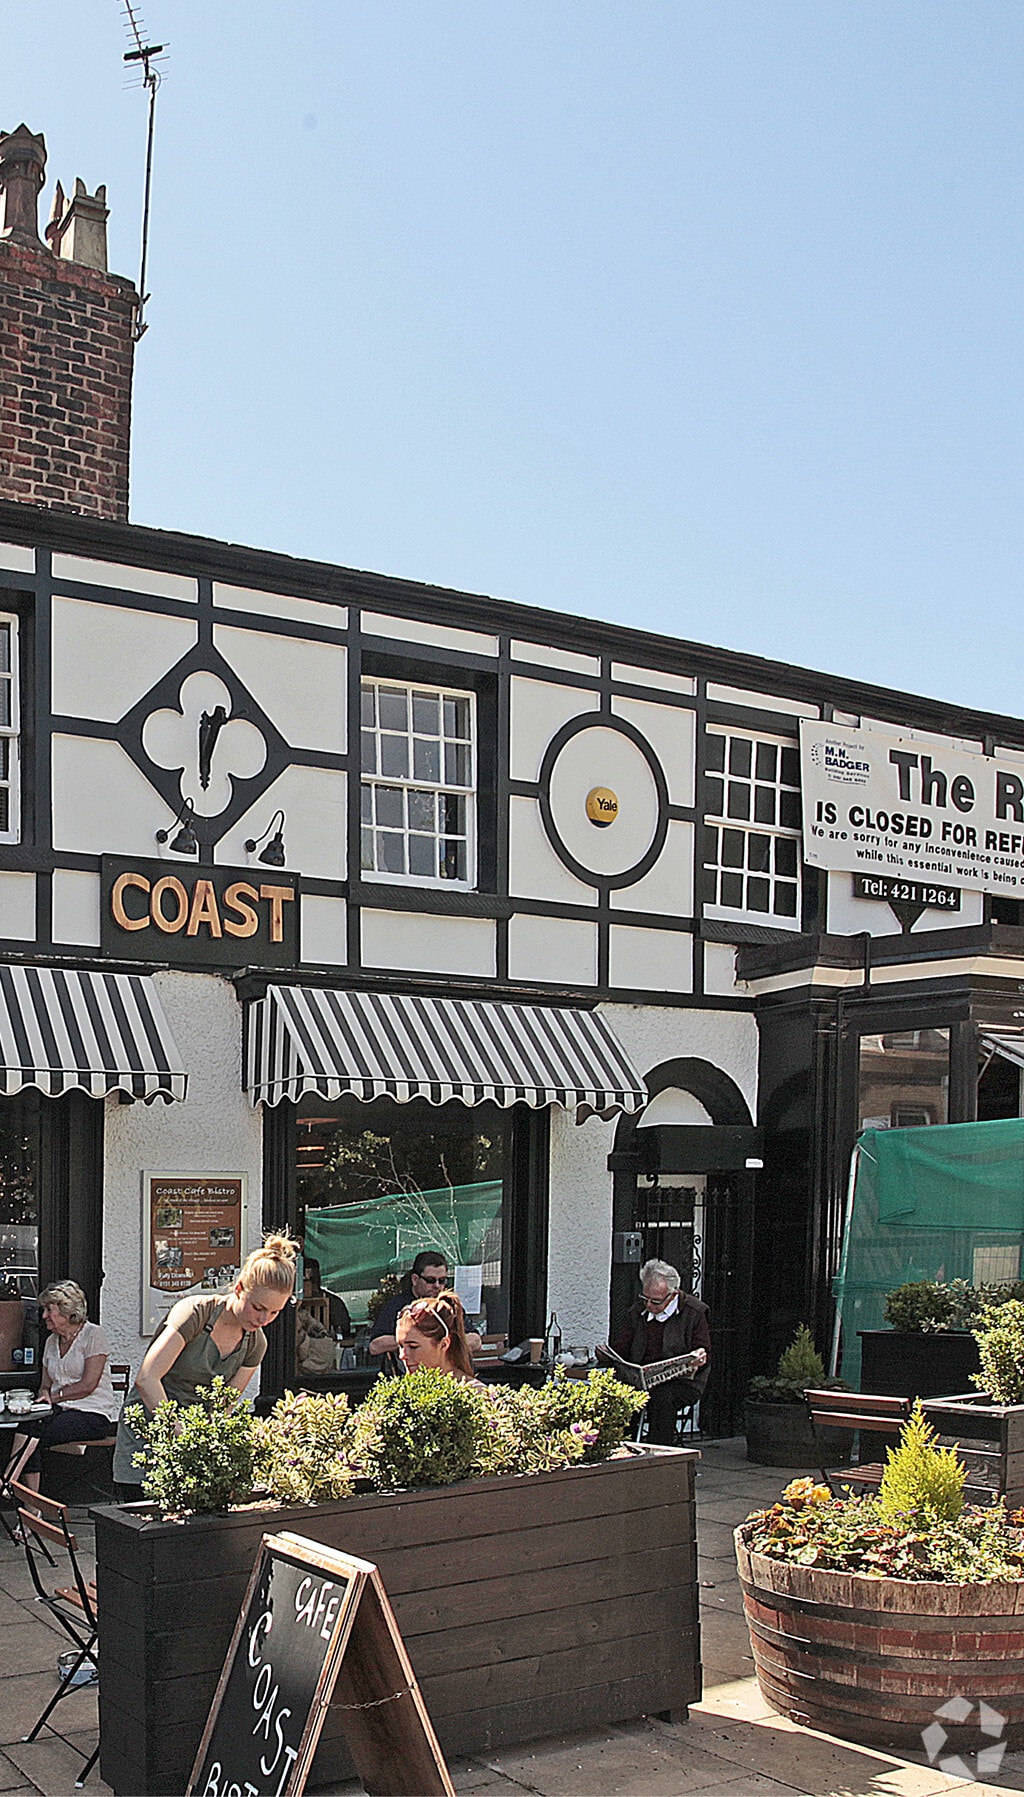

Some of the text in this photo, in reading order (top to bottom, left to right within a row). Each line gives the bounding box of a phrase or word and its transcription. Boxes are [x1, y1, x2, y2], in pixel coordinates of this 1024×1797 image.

[824, 756, 870, 773] BADGER
[825, 745, 849, 760] M.N.
[596, 797, 618, 812] Yale
[889, 748, 1024, 823] The R
[811, 823, 825, 838] We
[829, 830, 848, 841] are
[853, 832, 880, 847] sorry
[885, 836, 898, 848] for
[902, 841, 922, 854] any
[925, 842, 991, 864] inconvenience
[816, 801, 1024, 855] IS CLOSED FOR REF
[856, 848, 884, 862] while
[887, 853, 904, 866] this
[907, 859, 952, 874] essential
[955, 867, 978, 878] work
[981, 868, 989, 880] is
[993, 870, 1017, 886] being
[111, 871, 296, 944] COAST
[861, 878, 956, 906] Tel: 421 1264
[156, 1186, 236, 1197] Coast Cafe Bistro
[294, 1576, 340, 1641] CAFE
[248, 1611, 299, 1797] COAST
